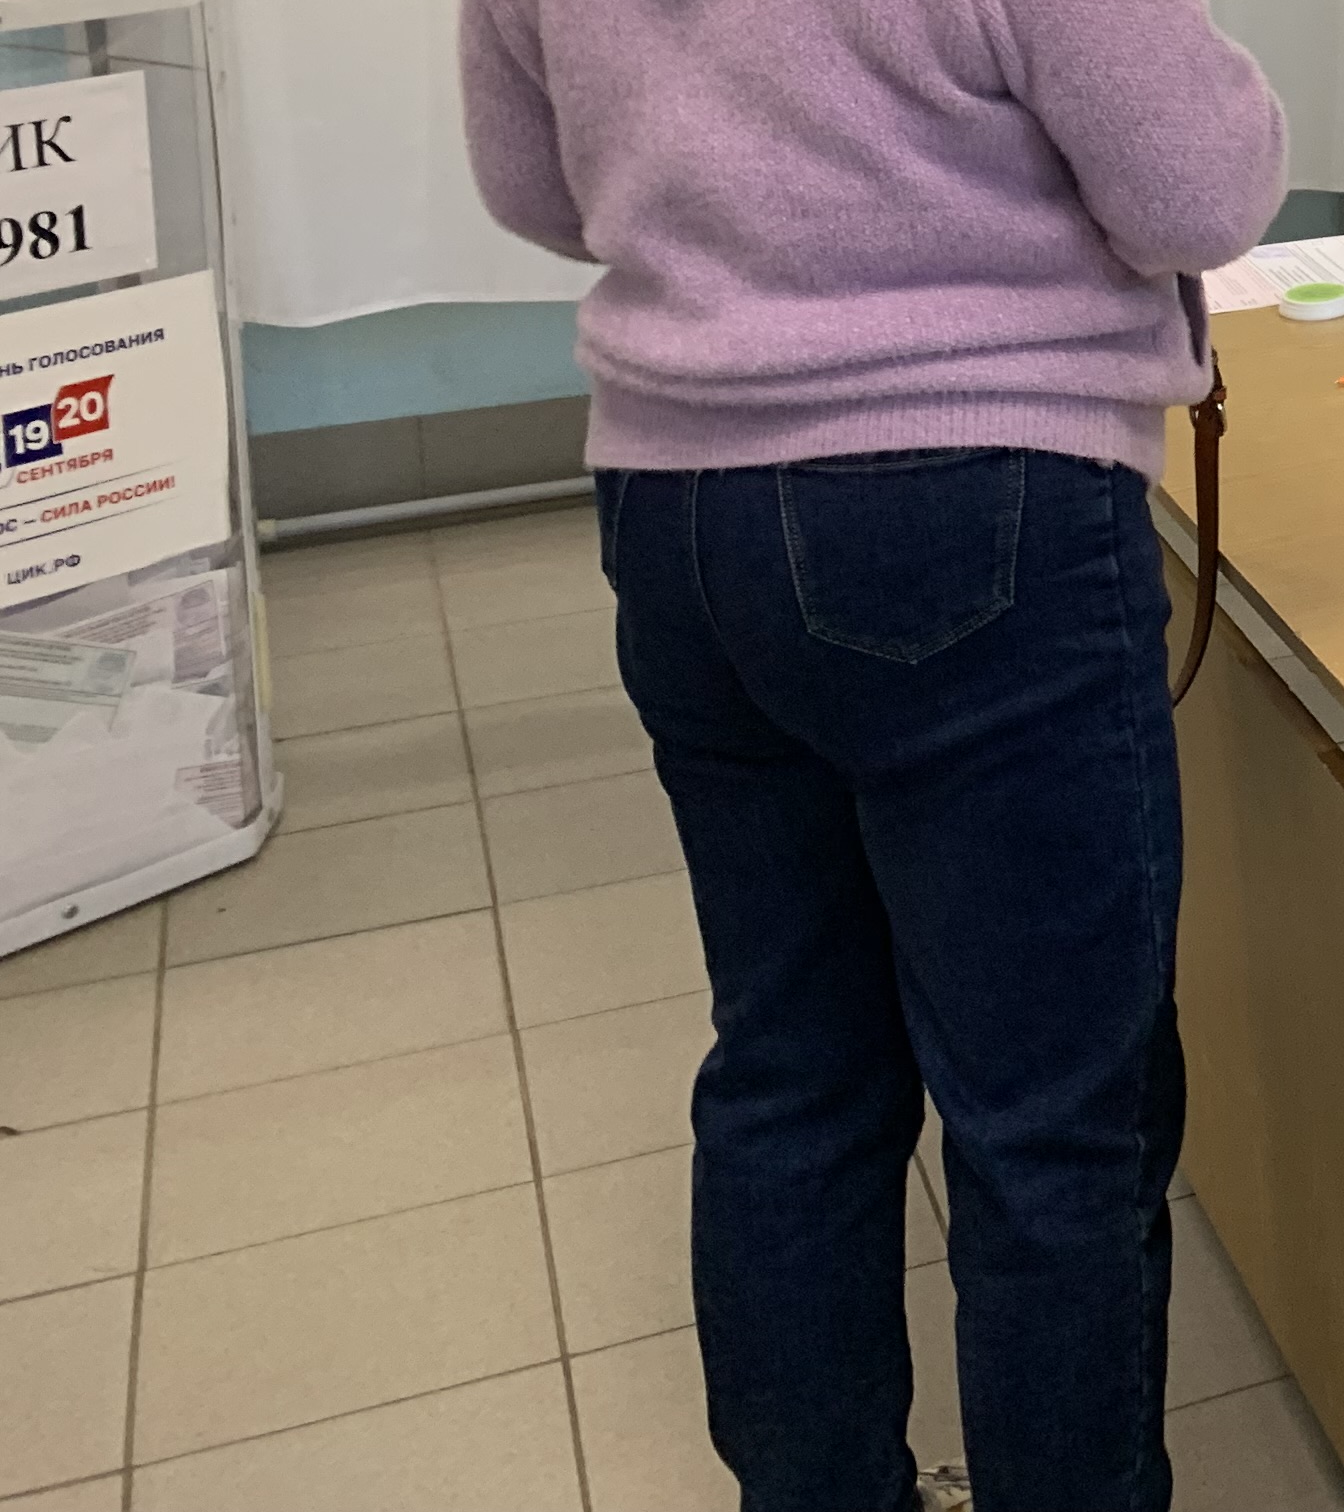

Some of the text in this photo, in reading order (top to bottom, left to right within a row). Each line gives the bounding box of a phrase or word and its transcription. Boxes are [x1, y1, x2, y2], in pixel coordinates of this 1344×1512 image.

[29, 328, 165, 371] ГОЛОСОВАНИЯ
[9, 391, 103, 455] 19 20
[17, 448, 114, 484] СЕНТЯБРЯ
[40, 500, 91, 523] СИЛА
[97, 476, 175, 508] РОССИИ!
